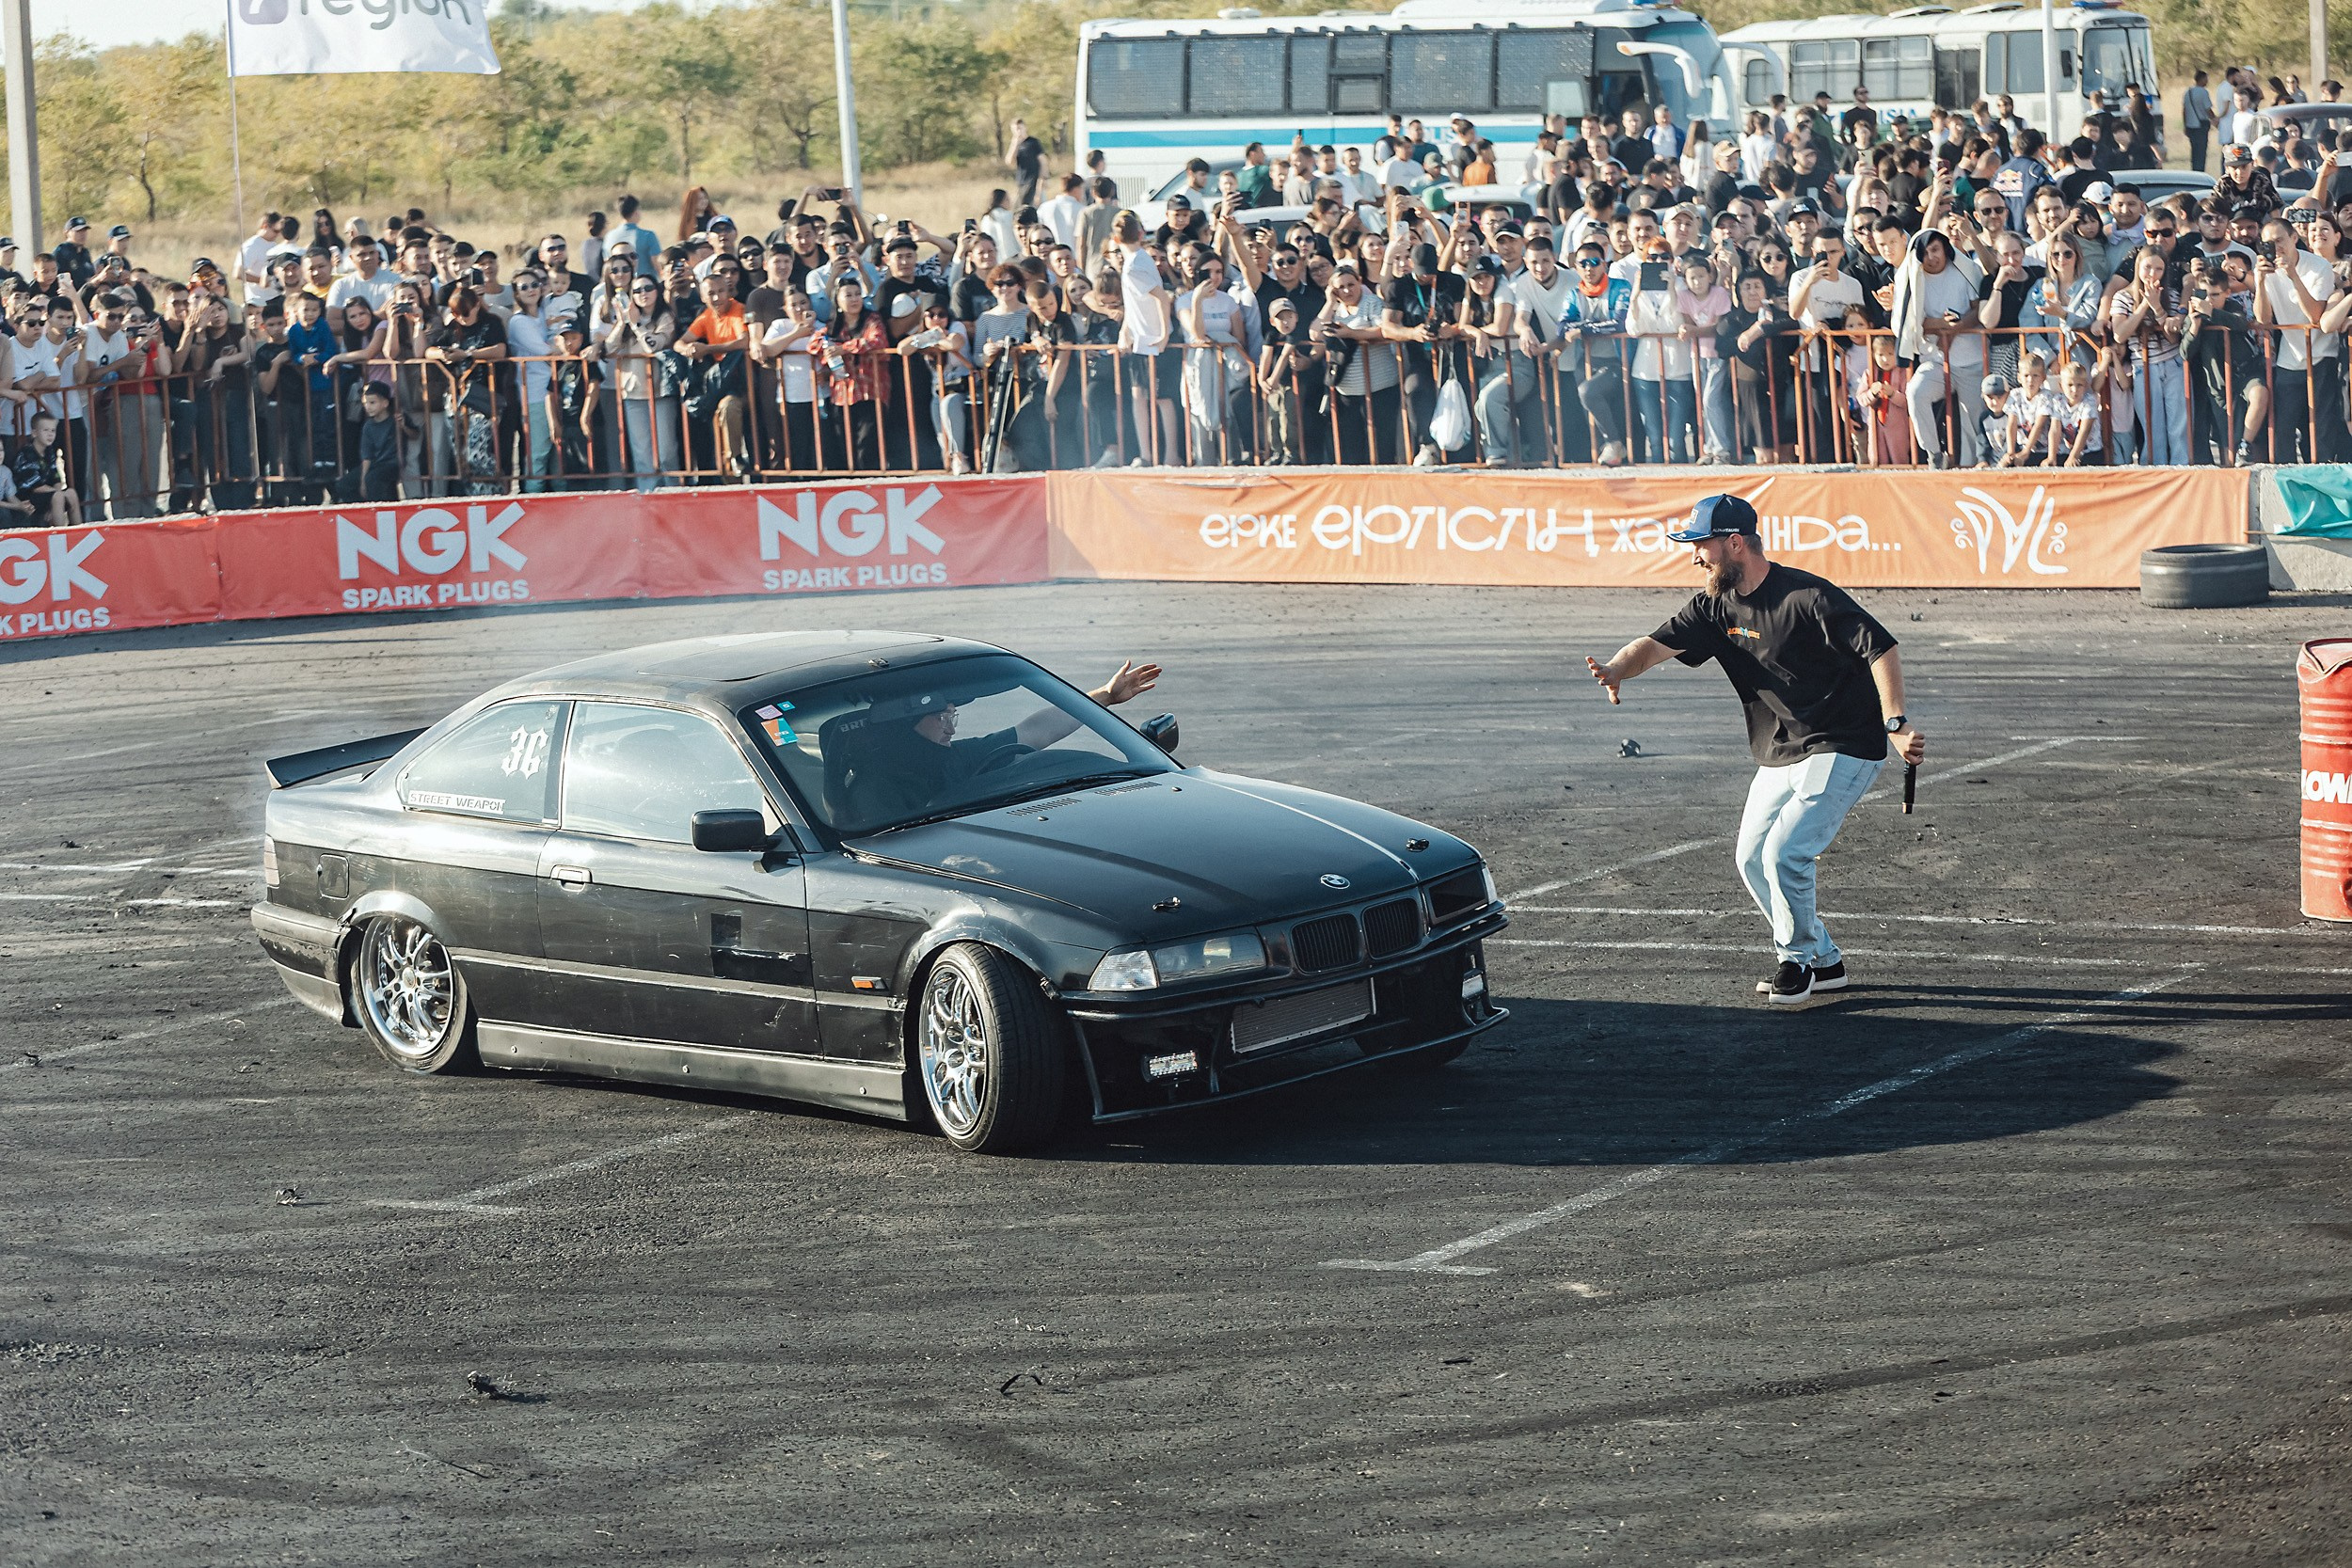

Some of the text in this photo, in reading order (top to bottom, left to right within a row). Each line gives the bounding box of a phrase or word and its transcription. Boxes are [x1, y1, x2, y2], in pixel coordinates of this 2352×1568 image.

[336, 500, 529, 580] NGK
[756, 483, 946, 562] NGK
[0, 529, 109, 605] GK
[763, 562, 947, 591] SPARK PLUGS
[342, 578, 530, 610] SPARK PLUGS
[20, 607, 111, 634] PLUGS
[501, 724, 549, 780] 36
[410, 793, 505, 812] STREET WEAPON
